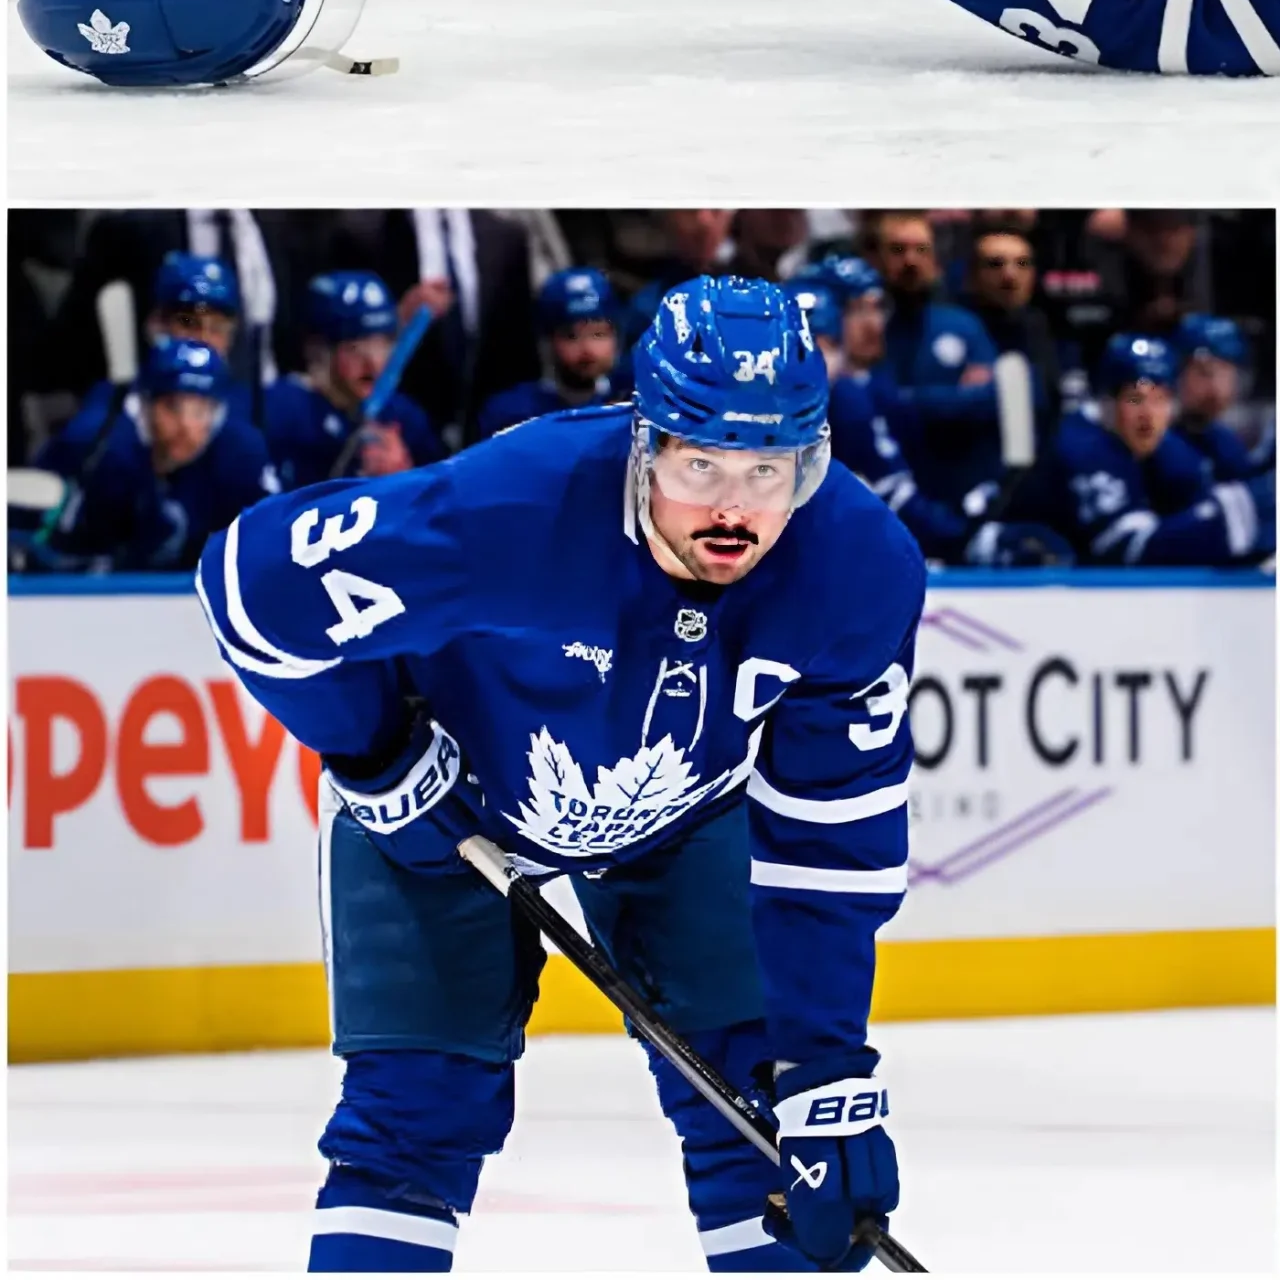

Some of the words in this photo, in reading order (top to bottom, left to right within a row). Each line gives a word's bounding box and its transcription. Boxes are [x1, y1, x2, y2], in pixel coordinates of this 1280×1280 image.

[732, 347, 780, 385] 34
[290, 495, 406, 647] 34
[733, 656, 802, 723] C
